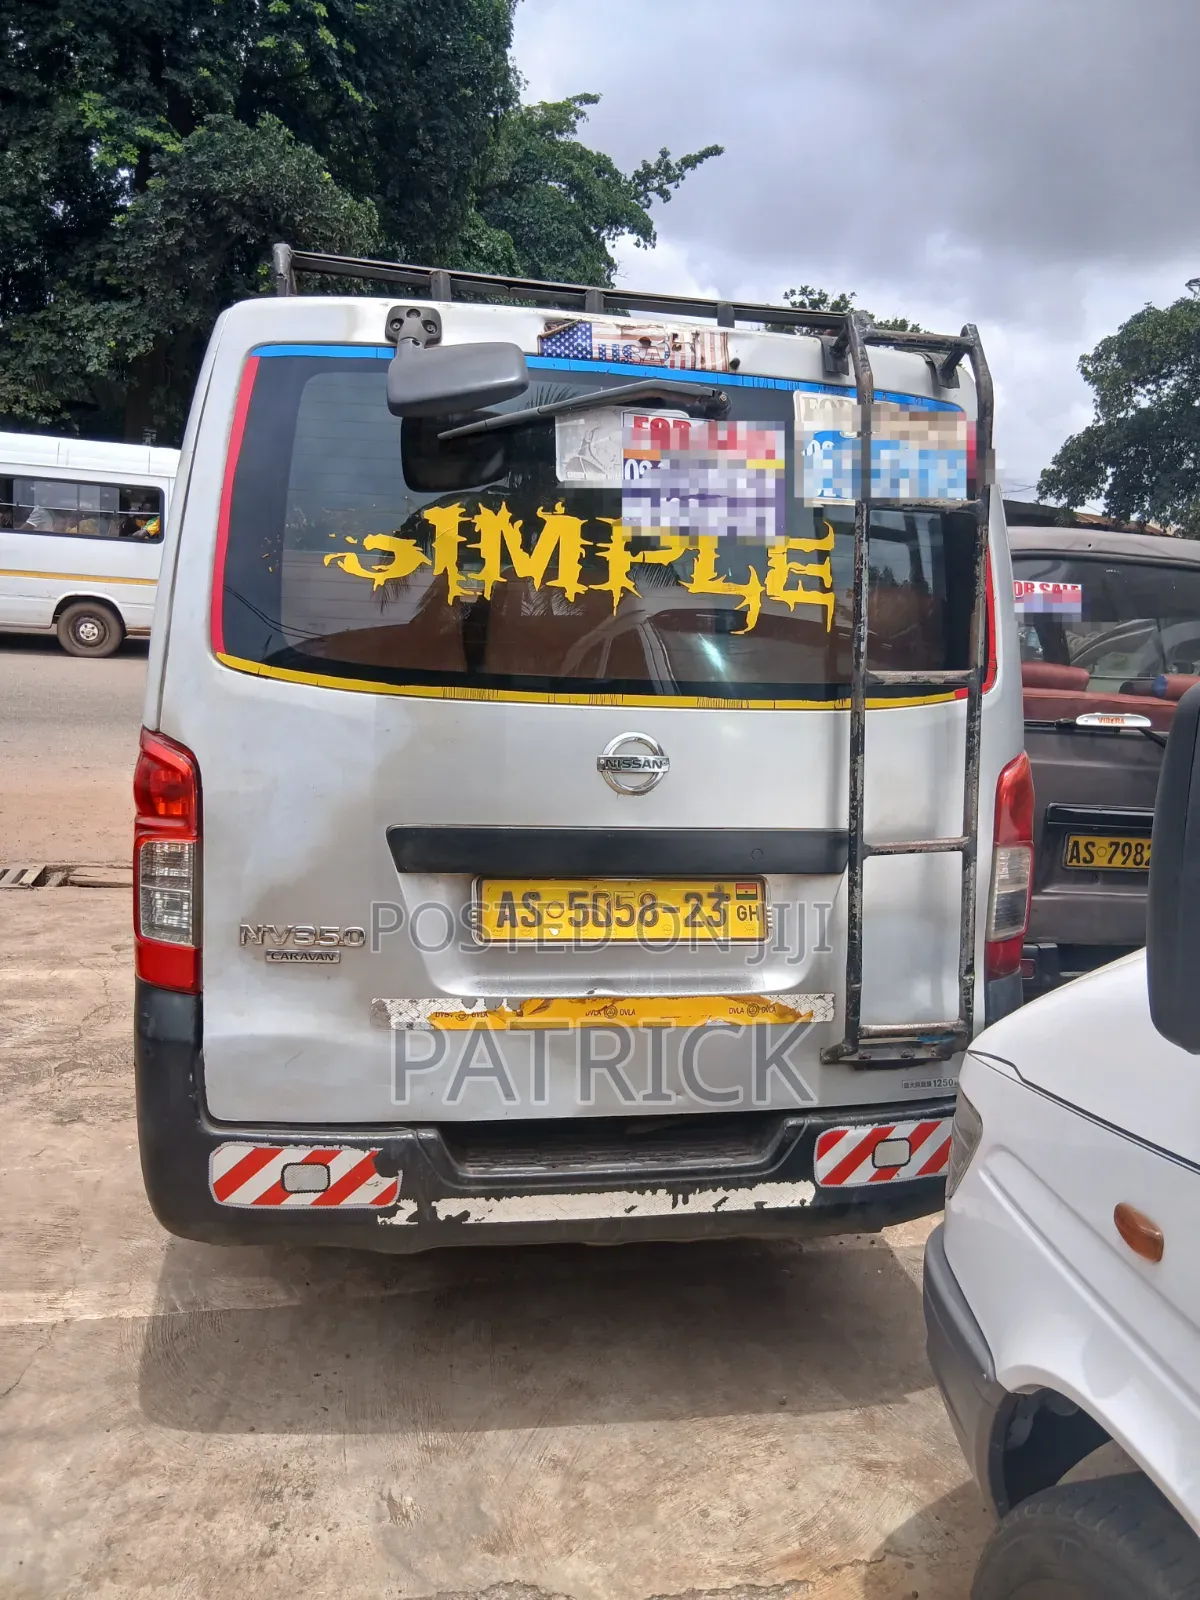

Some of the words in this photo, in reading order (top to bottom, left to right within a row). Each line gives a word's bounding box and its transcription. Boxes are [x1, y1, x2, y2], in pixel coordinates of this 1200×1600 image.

[1013, 581, 1035, 597] OR
[605, 759, 663, 769] NISSAN
[1068, 840, 1096, 865] AS
[496, 891, 542, 928] AS
[736, 904, 760, 922] GH
[239, 924, 366, 947] NV350
[271, 951, 335, 961] CARAVAN
[619, 1008, 636, 1016] DVLA
[728, 1007, 745, 1015] DVLA
[933, 1078, 954, 1088] 1250
